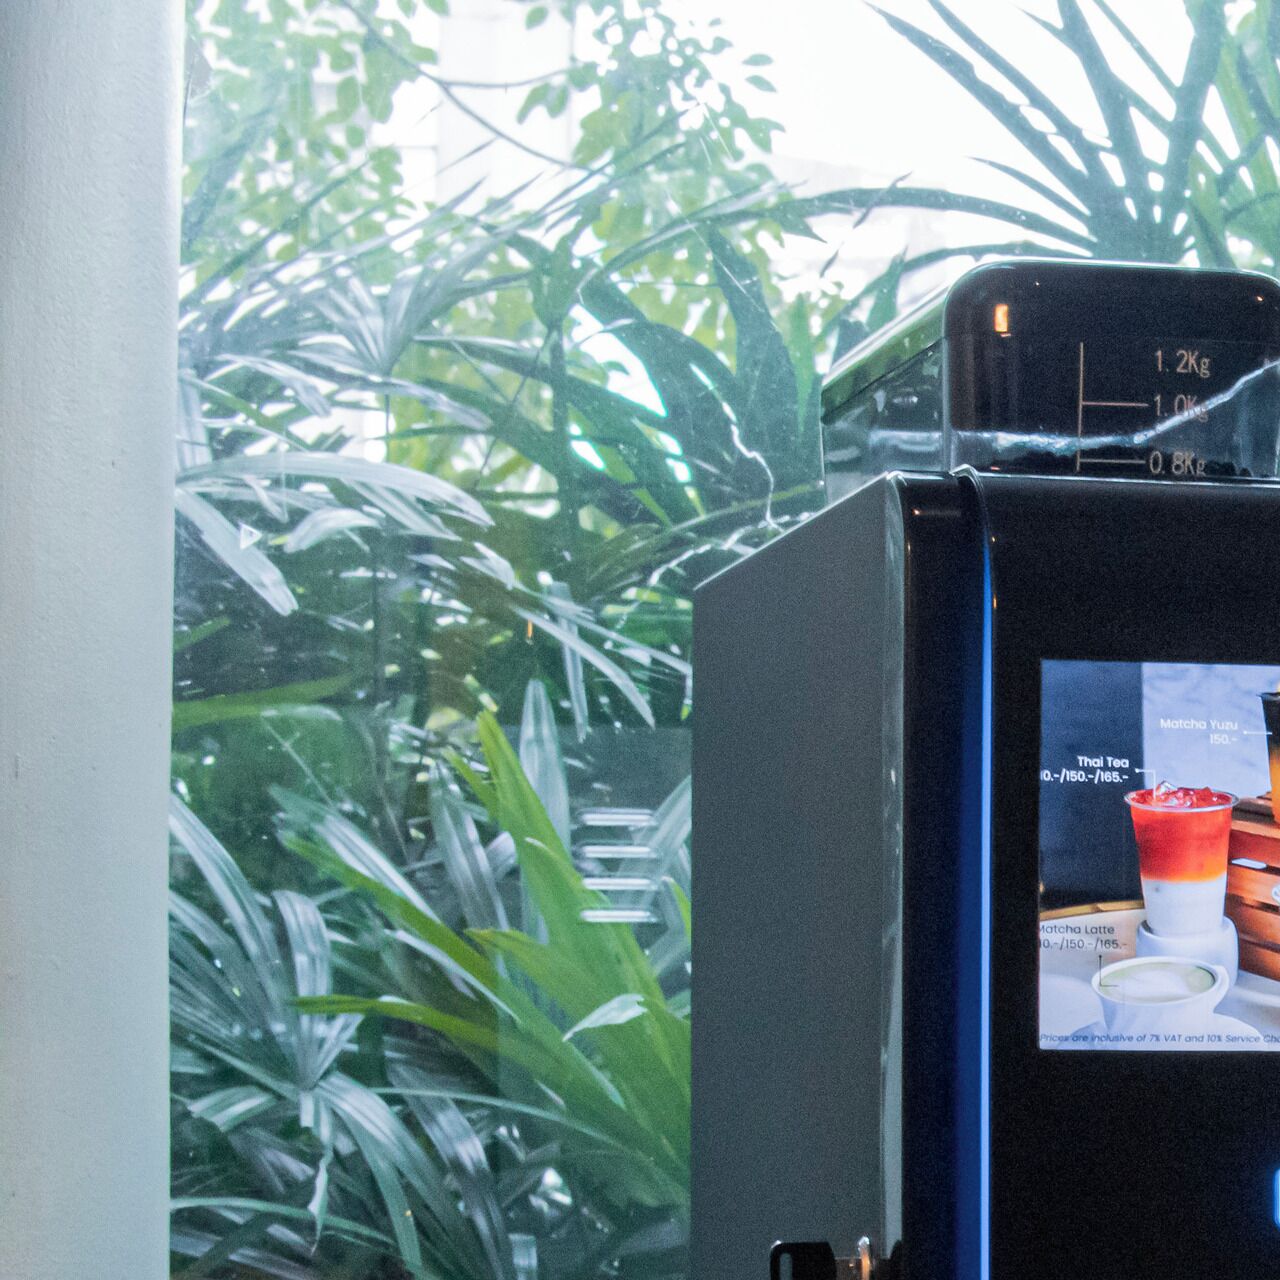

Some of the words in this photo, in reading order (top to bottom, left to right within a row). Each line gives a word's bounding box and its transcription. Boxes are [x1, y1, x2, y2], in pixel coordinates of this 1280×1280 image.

[1160, 718, 1207, 730] Matcha
[1209, 719, 1239, 731] Yuzu
[1077, 755, 1104, 768] Thai
[1106, 756, 1130, 768] Tea
[1084, 925, 1115, 935] Latte
[1040, 1033, 1070, 1042] Prices
[1072, 1034, 1089, 1042] are
[1136, 1033, 1147, 1042] of
[1164, 1034, 1182, 1043] VAT
[1184, 1034, 1205, 1043] and
[1225, 1034, 1260, 1043] Service
